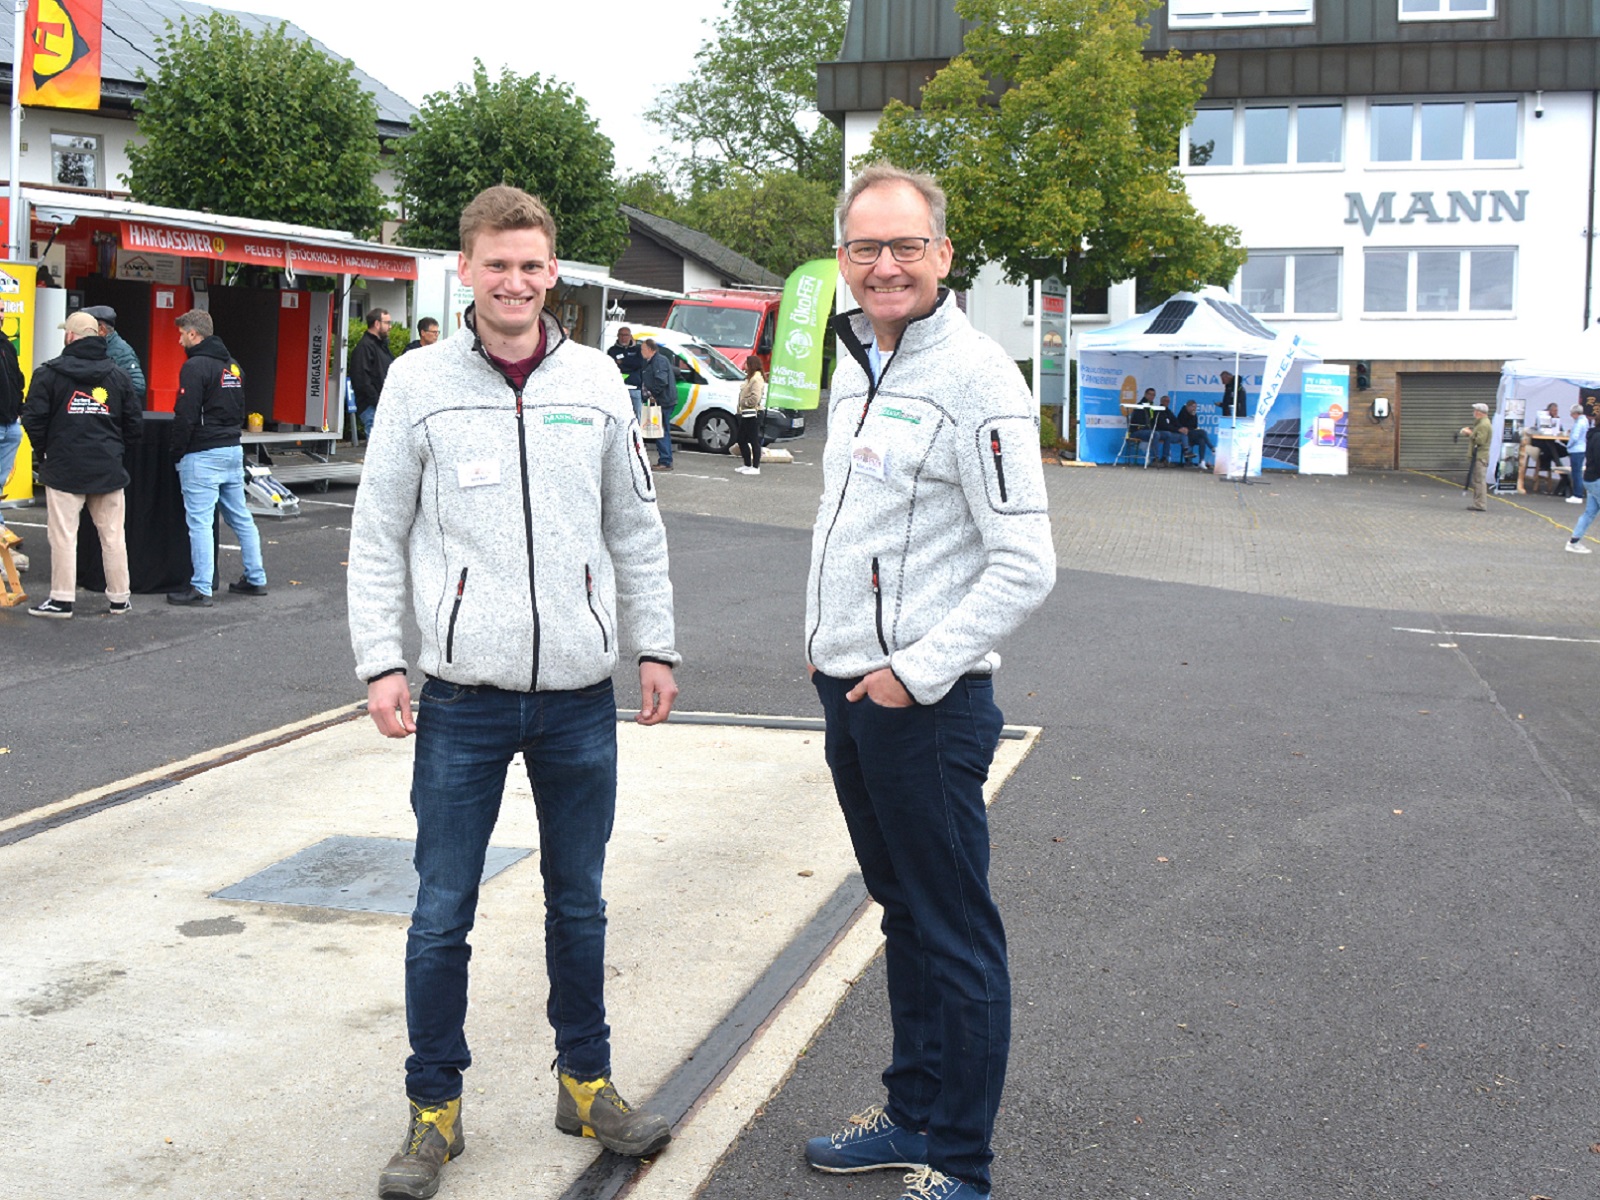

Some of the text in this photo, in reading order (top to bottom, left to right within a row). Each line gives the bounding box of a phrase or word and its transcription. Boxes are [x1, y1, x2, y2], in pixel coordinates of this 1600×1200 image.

[1343, 190, 1529, 236] MANN
[129, 224, 213, 253] HARGASSNER
[310, 335, 323, 397] HARGASSNER
[770, 375, 786, 386] aus
[772, 366, 806, 379] Wärme
[1258, 347, 1295, 416] ENATEK
